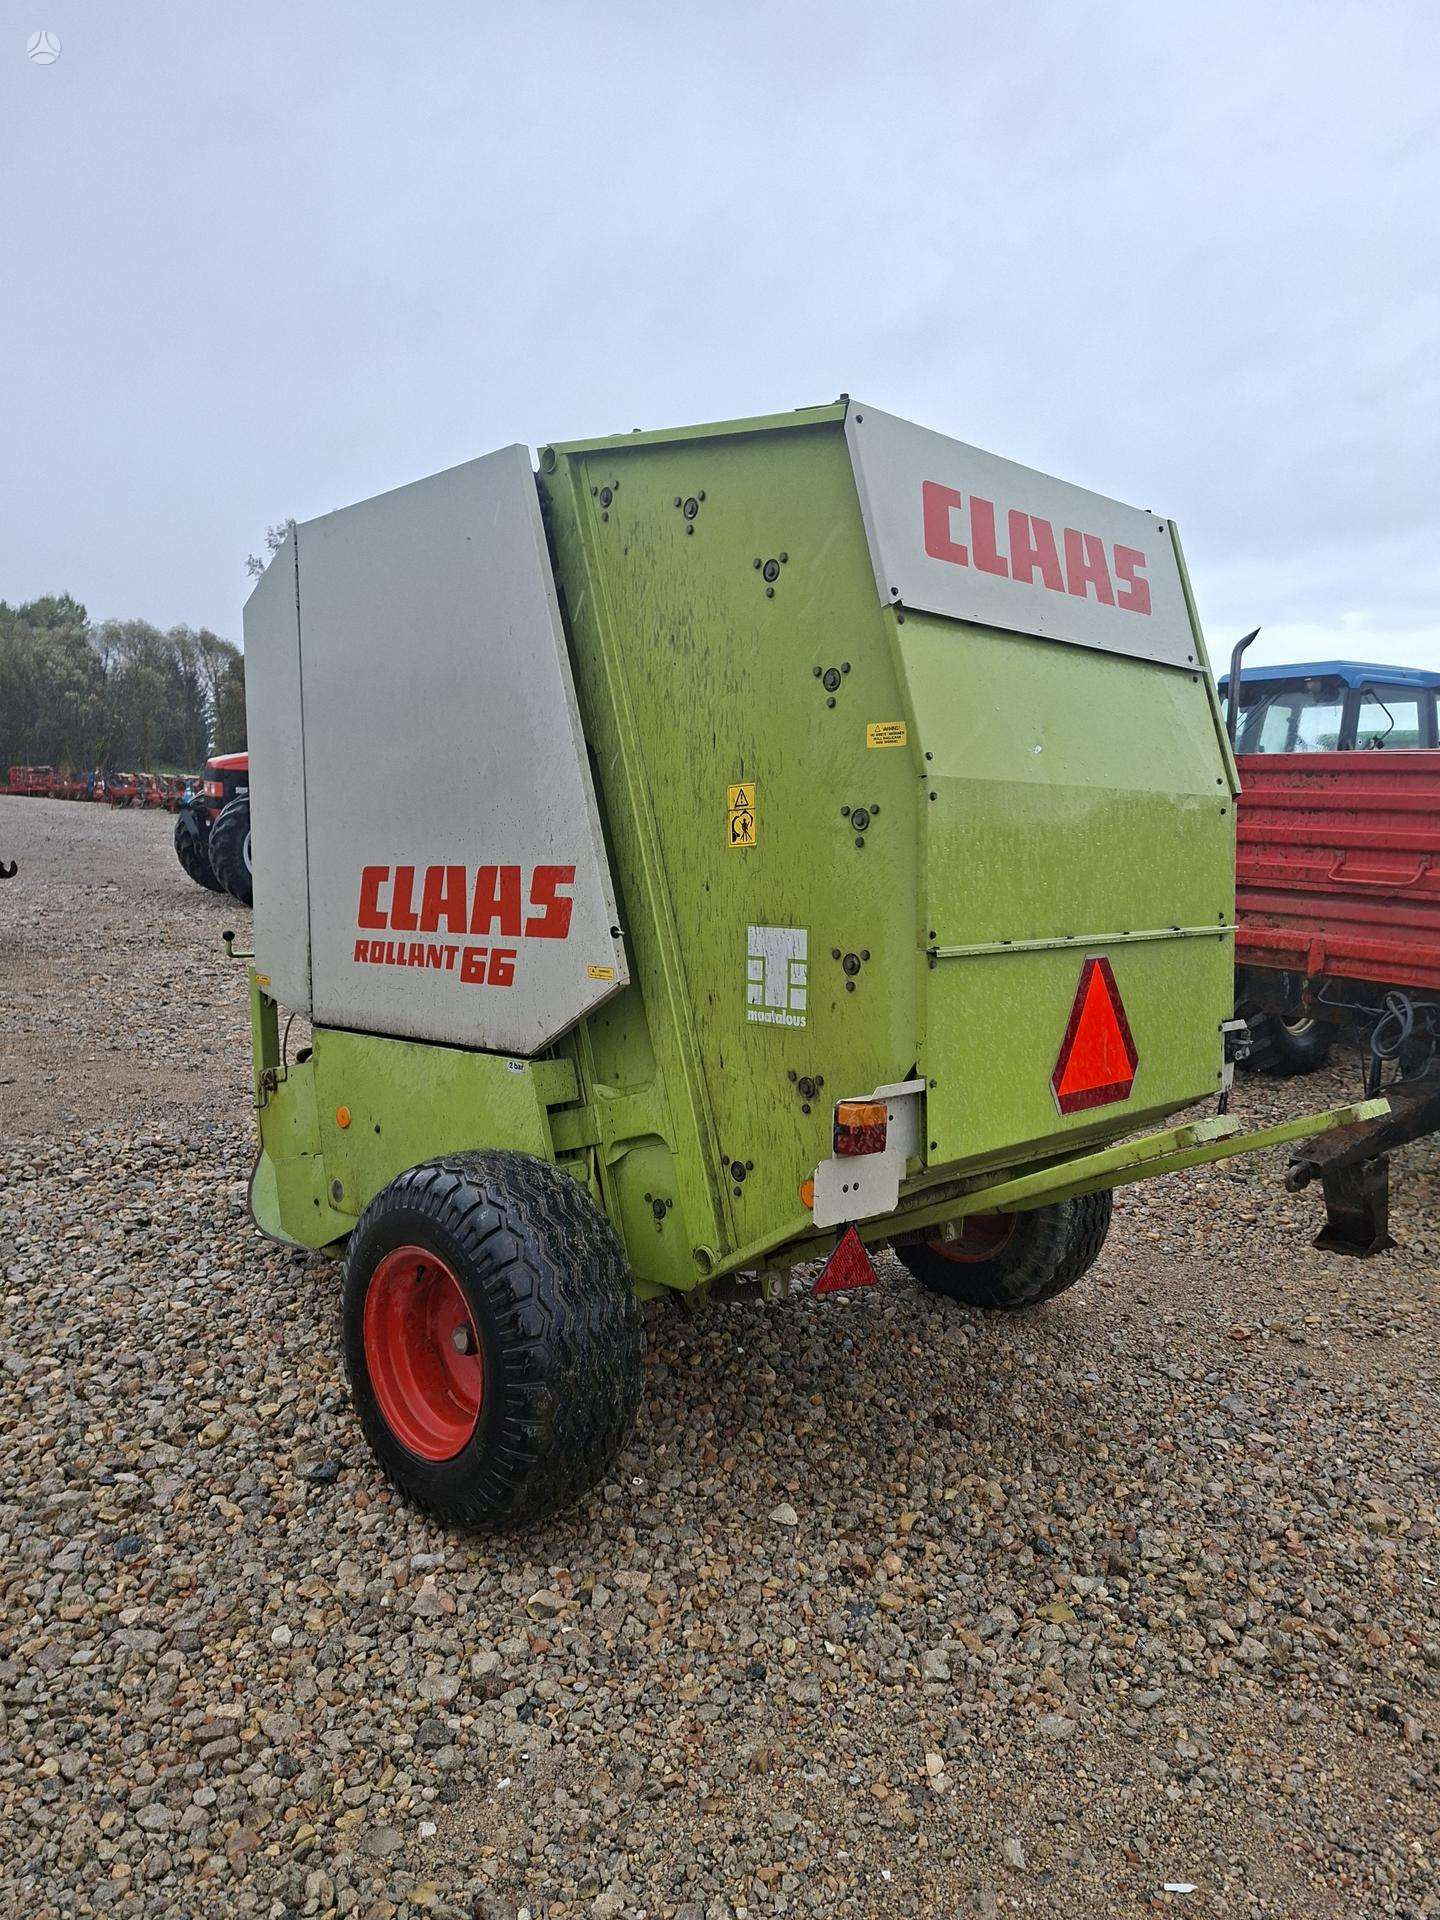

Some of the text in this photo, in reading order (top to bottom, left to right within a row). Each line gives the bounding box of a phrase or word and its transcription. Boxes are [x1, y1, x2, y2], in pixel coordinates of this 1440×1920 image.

[922, 479, 1152, 616] CLAAS
[357, 865, 577, 939] CLAAS
[354, 939, 518, 986] ROLLANT 66
